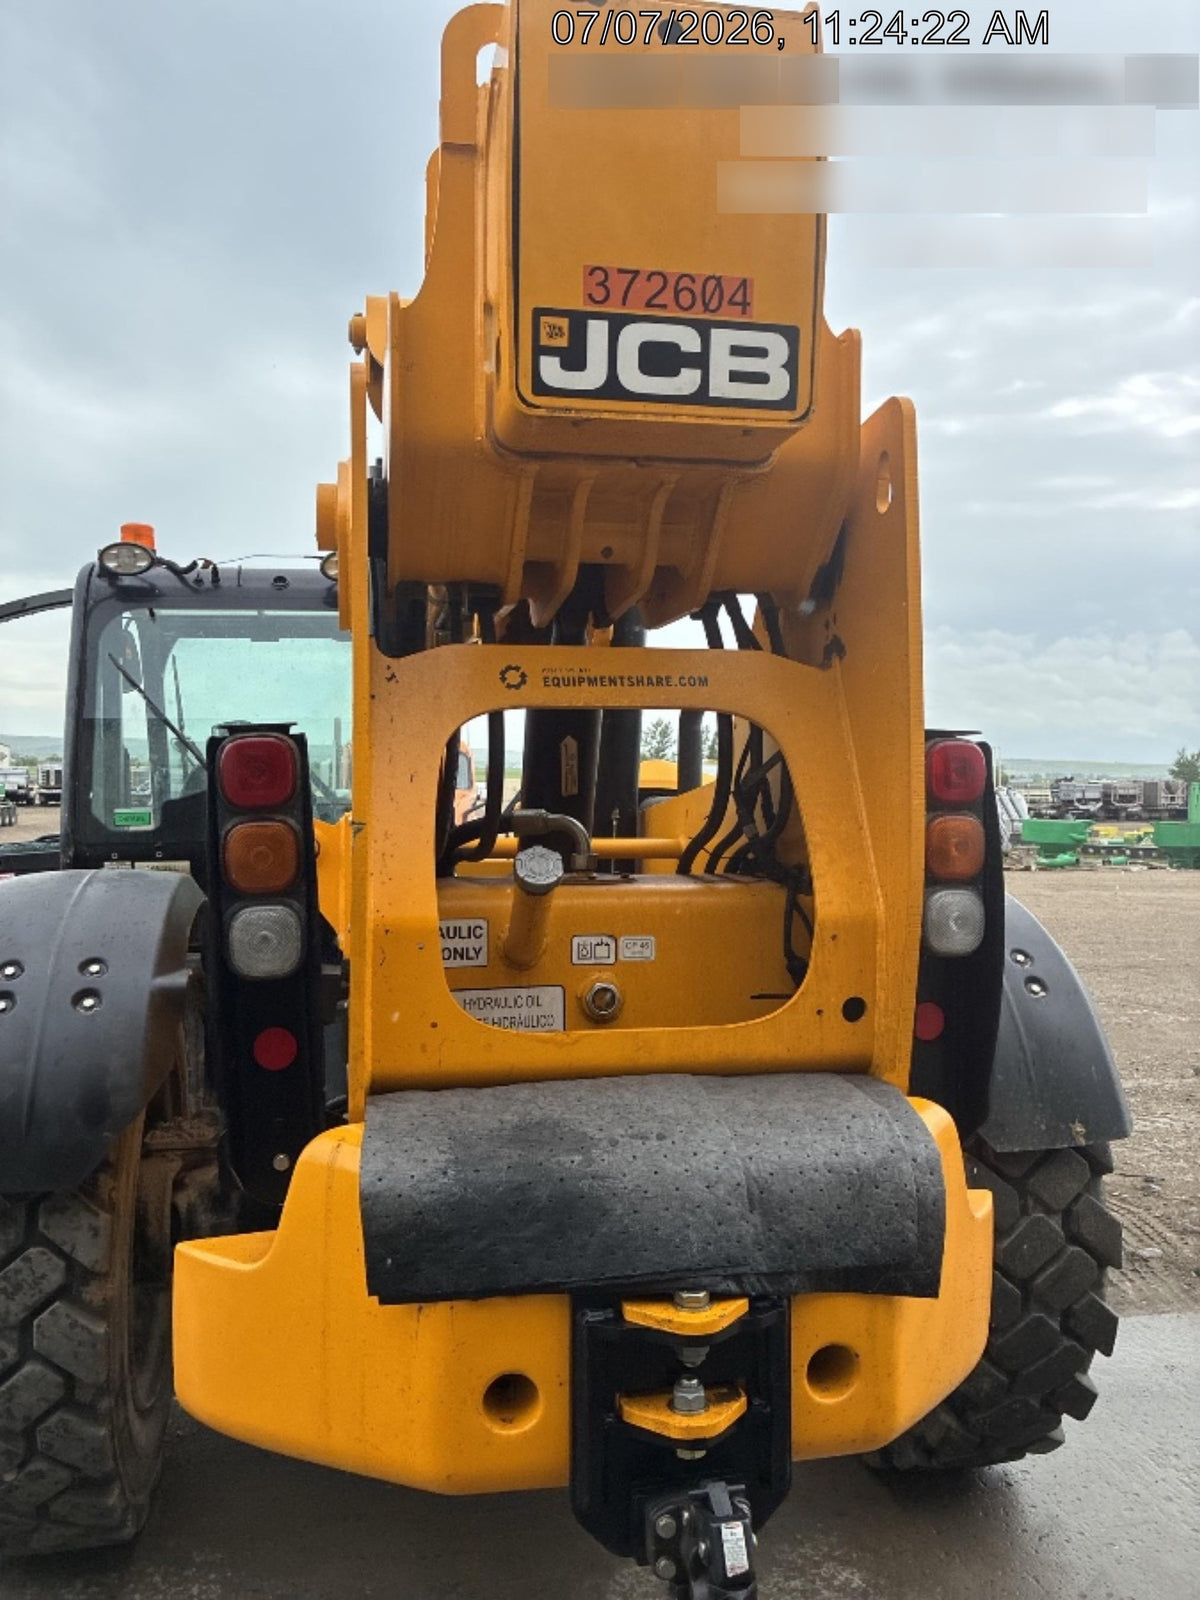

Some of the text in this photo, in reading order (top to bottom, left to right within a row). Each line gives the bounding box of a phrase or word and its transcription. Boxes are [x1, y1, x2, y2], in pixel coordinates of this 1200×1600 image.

[587, 265, 751, 315] 372604
[539, 319, 790, 401] JCB
[542, 675, 709, 688] EQUIPMENTSHARE.COM
[442, 946, 482, 960] ONLY
[463, 994, 542, 1011] HYDRAULIC OIL
